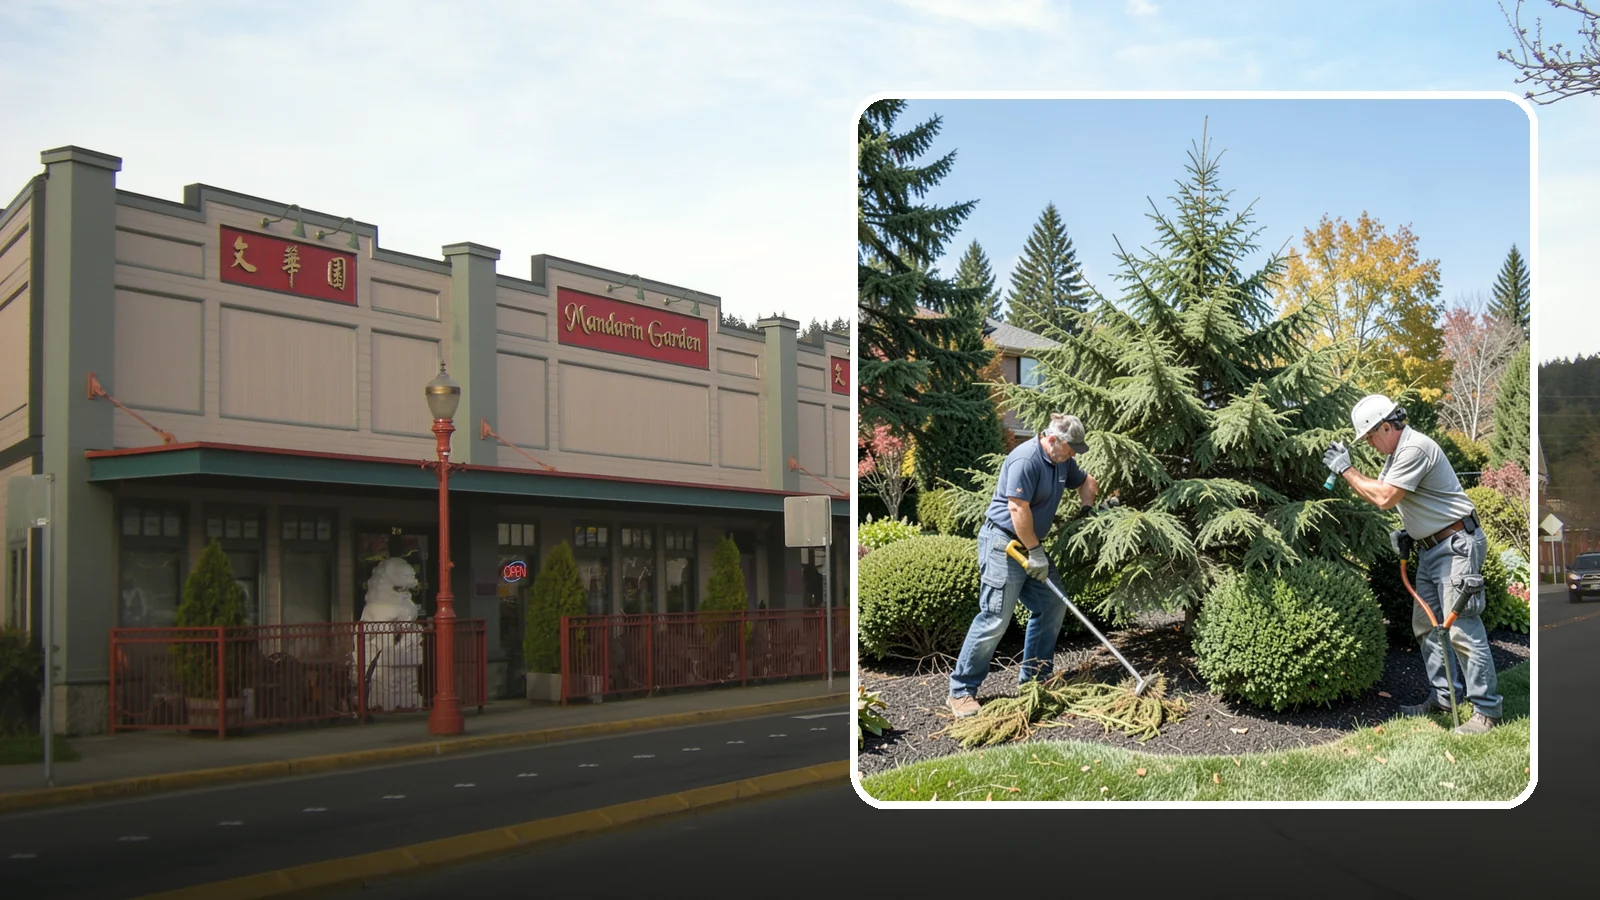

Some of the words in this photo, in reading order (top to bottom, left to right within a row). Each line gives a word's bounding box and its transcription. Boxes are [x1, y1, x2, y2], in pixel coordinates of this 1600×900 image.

[230, 235, 347, 291] 文華園
[564, 302, 645, 342] Mandarin
[647, 320, 702, 352] Garden
[503, 565, 527, 578] OPEN
